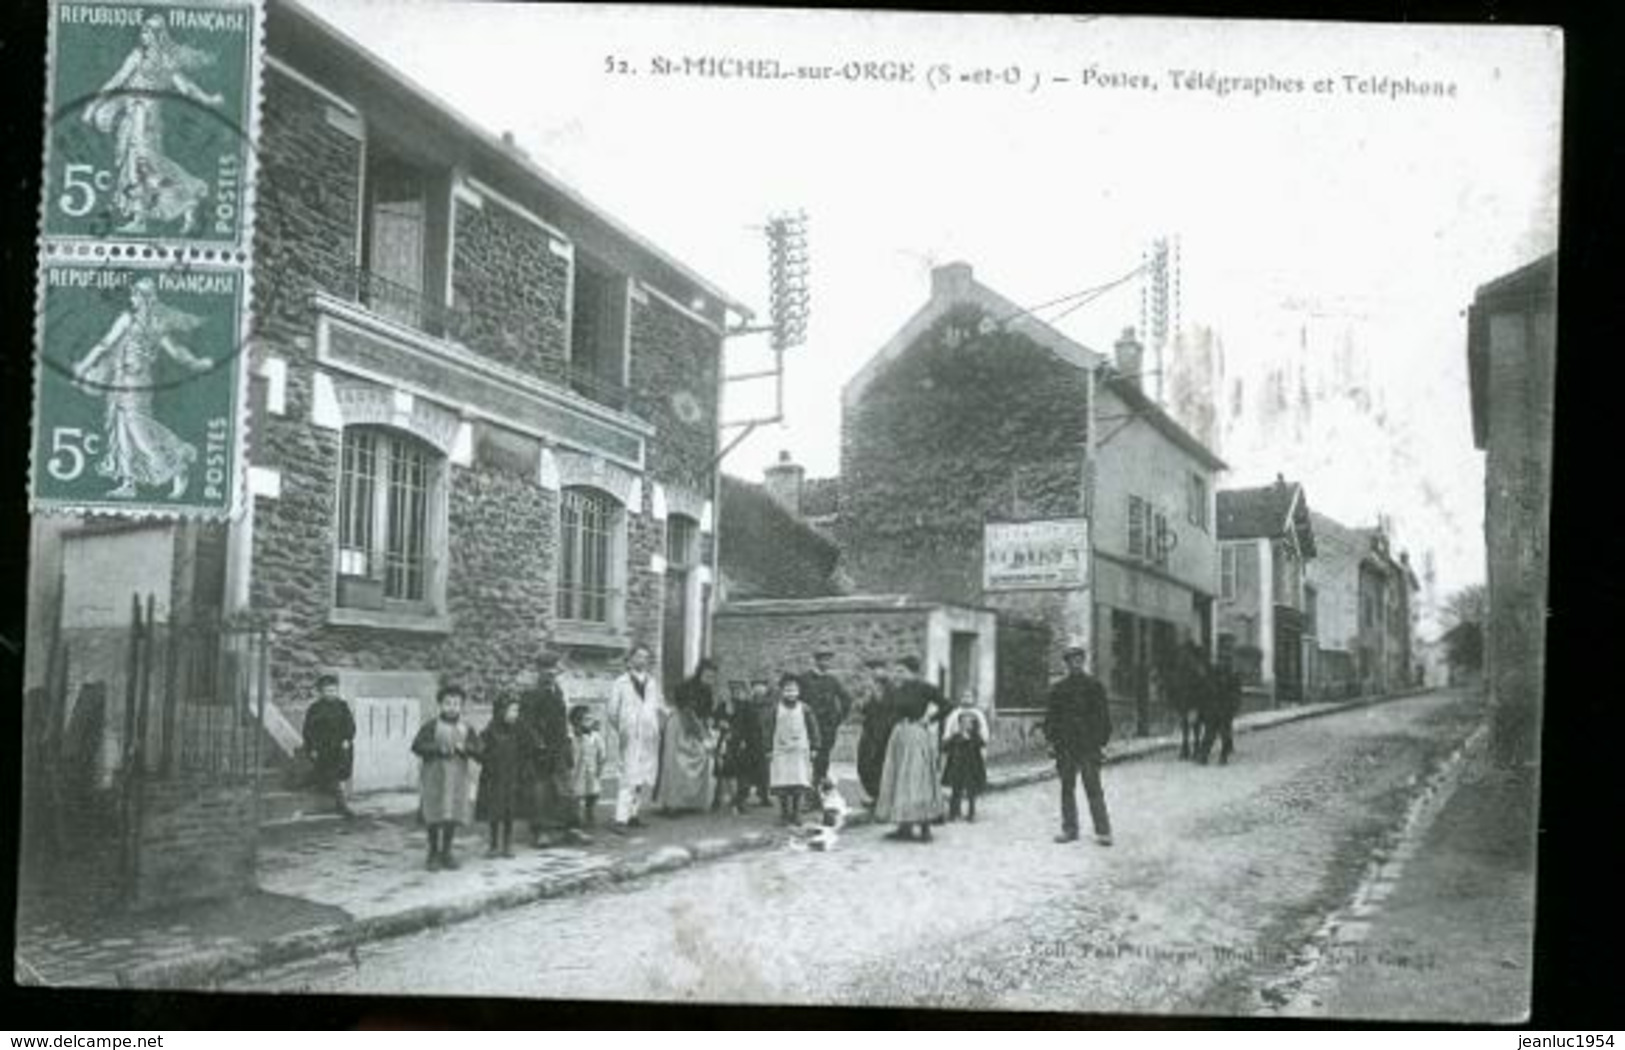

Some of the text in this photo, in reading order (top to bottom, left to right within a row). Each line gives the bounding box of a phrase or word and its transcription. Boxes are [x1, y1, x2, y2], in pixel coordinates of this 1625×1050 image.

[1312, 77, 1335, 95] et
[214, 153, 238, 235] POSTES
[203, 416, 227, 500] POSTES
